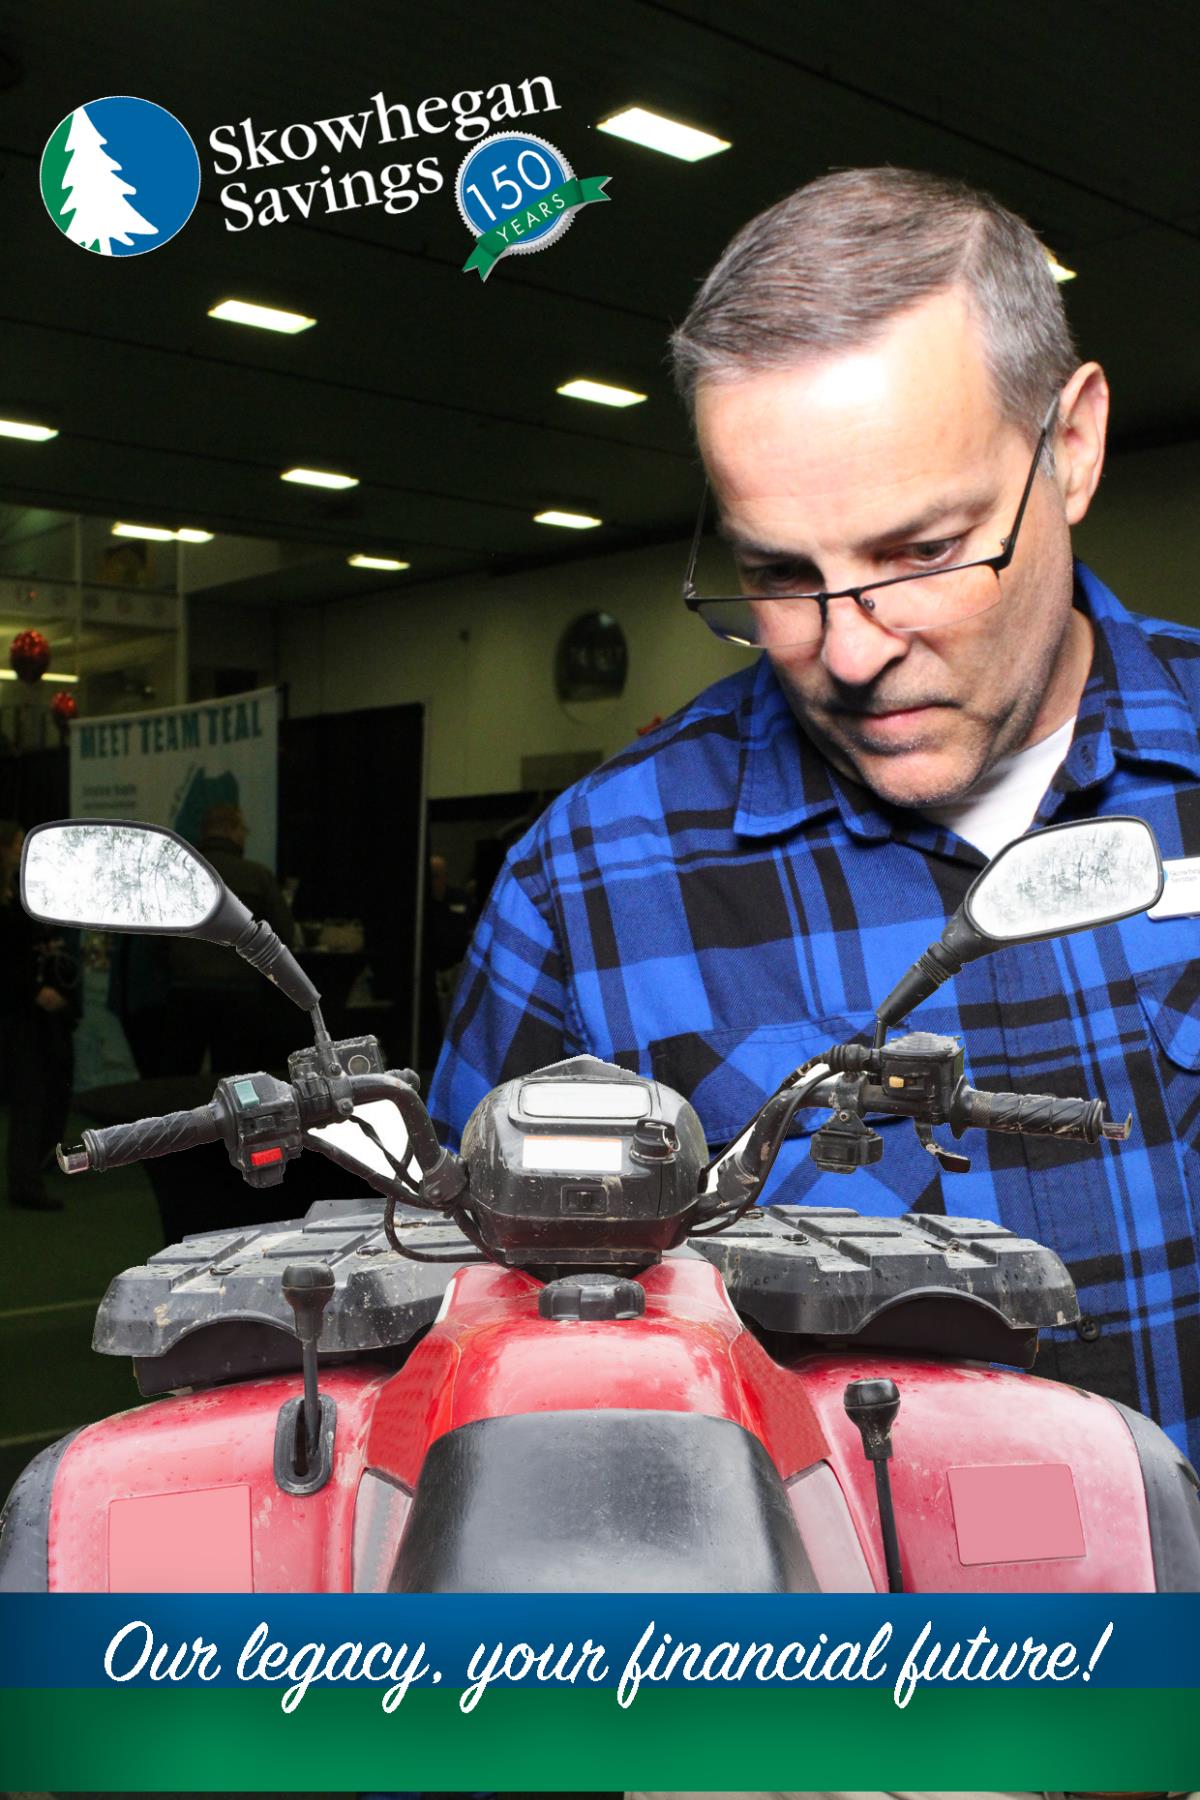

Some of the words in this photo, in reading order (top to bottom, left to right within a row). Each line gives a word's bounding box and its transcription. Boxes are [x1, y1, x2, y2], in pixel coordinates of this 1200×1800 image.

[81, 723, 130, 758] MEET
[140, 712, 199, 754] TEAM
[208, 702, 262, 745] TEAL
